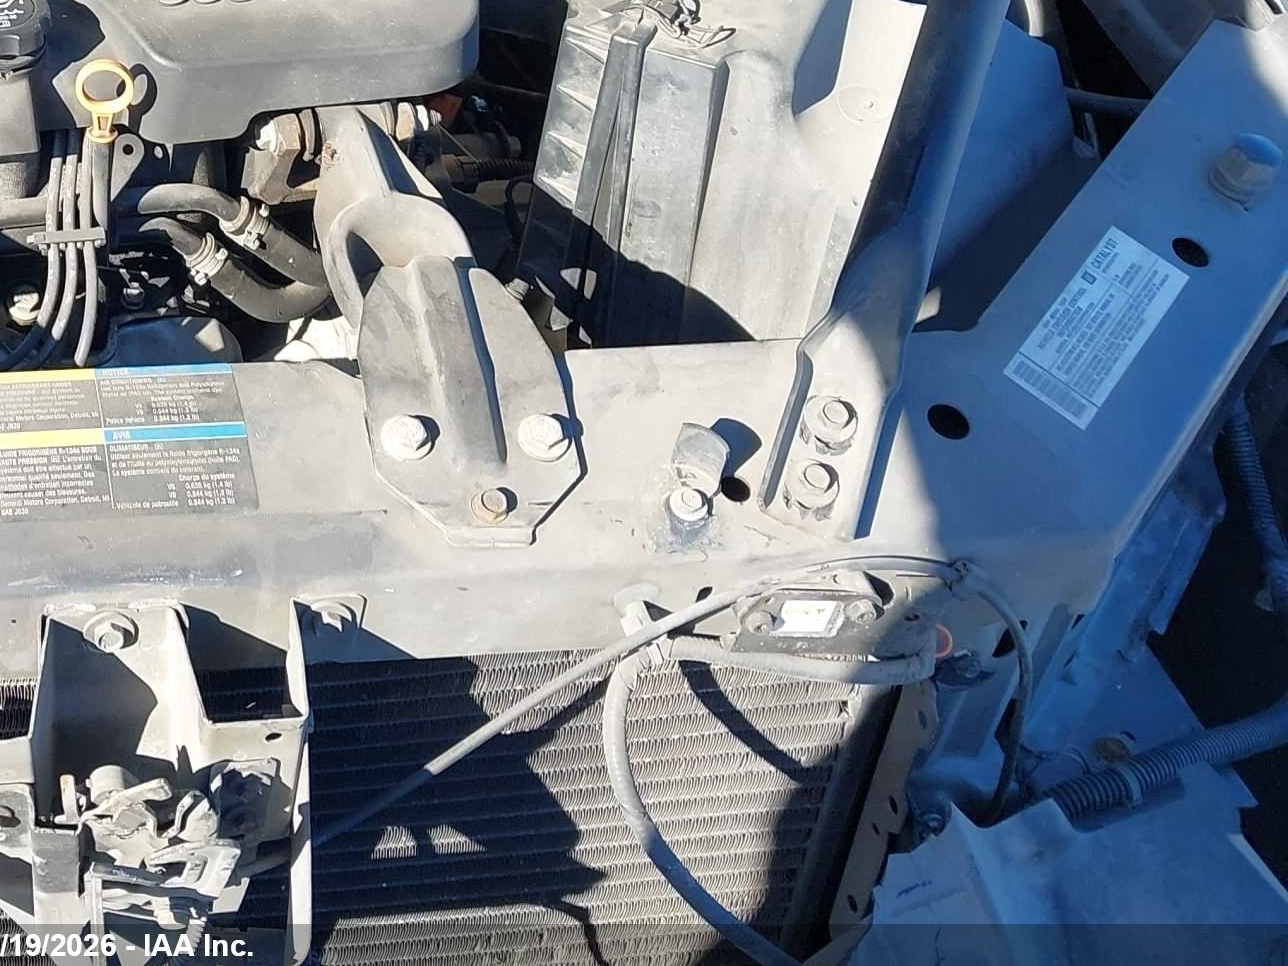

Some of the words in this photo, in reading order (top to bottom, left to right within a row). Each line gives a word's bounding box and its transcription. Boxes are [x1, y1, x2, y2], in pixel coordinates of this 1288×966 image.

[1090, 237, 1118, 269] CATALYST
[102, 368, 129, 376] NOTICE
[112, 431, 130, 439] AVIS
[17, 456, 47, 464] PRESSION
[23, 498, 43, 506] Motors
